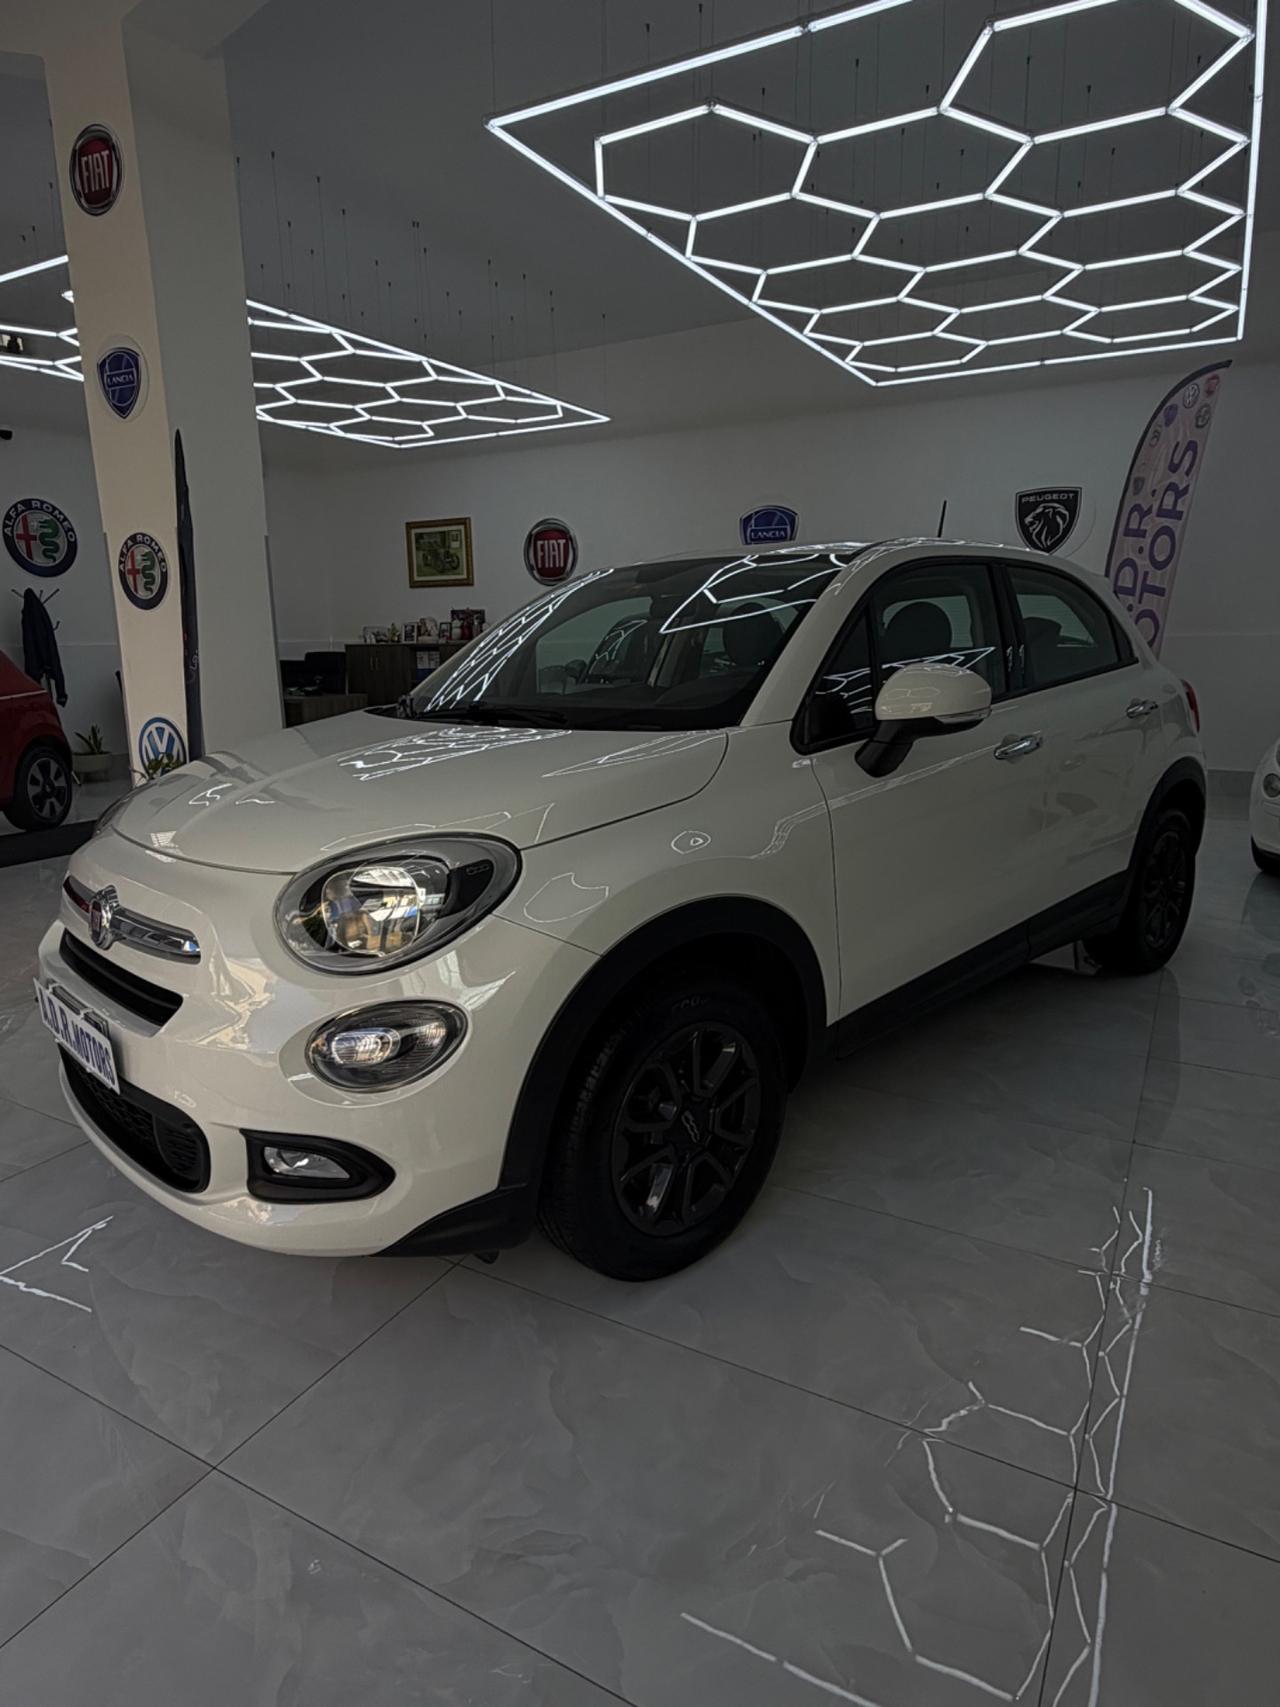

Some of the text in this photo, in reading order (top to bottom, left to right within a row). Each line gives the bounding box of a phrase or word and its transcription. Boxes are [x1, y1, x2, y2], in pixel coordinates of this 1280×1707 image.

[80, 148, 110, 195] FIAT
[1021, 493, 1075, 504] PEUGEOT
[4, 500, 76, 542] ALFA ROMEO
[751, 530, 786, 539] LANCIA
[136, 534, 167, 573] ROMEO
[536, 538, 567, 569] FIAT
[1113, 488, 1157, 613] .D.R.
[1135, 439, 1198, 648] OTORS
